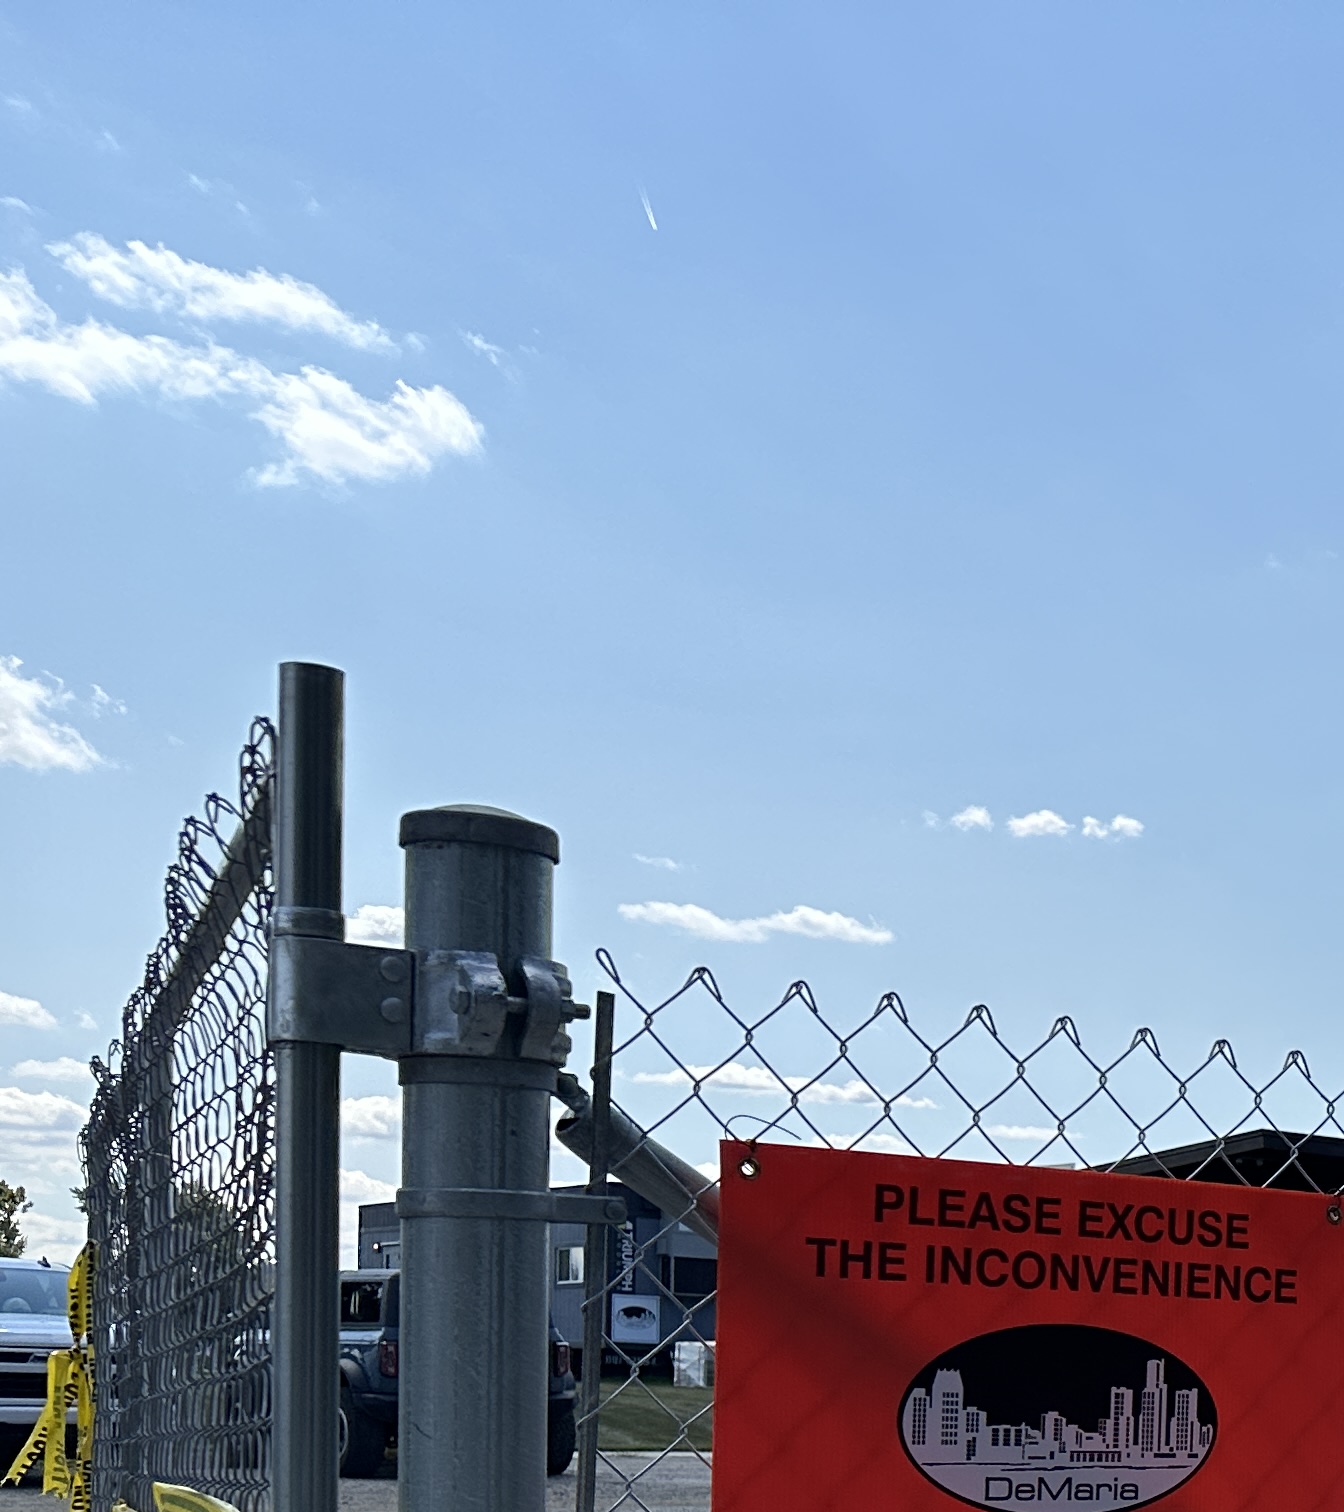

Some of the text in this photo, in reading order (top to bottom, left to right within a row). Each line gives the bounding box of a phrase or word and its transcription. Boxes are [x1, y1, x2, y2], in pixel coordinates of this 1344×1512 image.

[874, 1183, 1249, 1249] PLEASE EXCUSE
[806, 1237, 1297, 1303] THE INCONVENIENCE
[984, 1477, 1138, 1500] DeMaria
